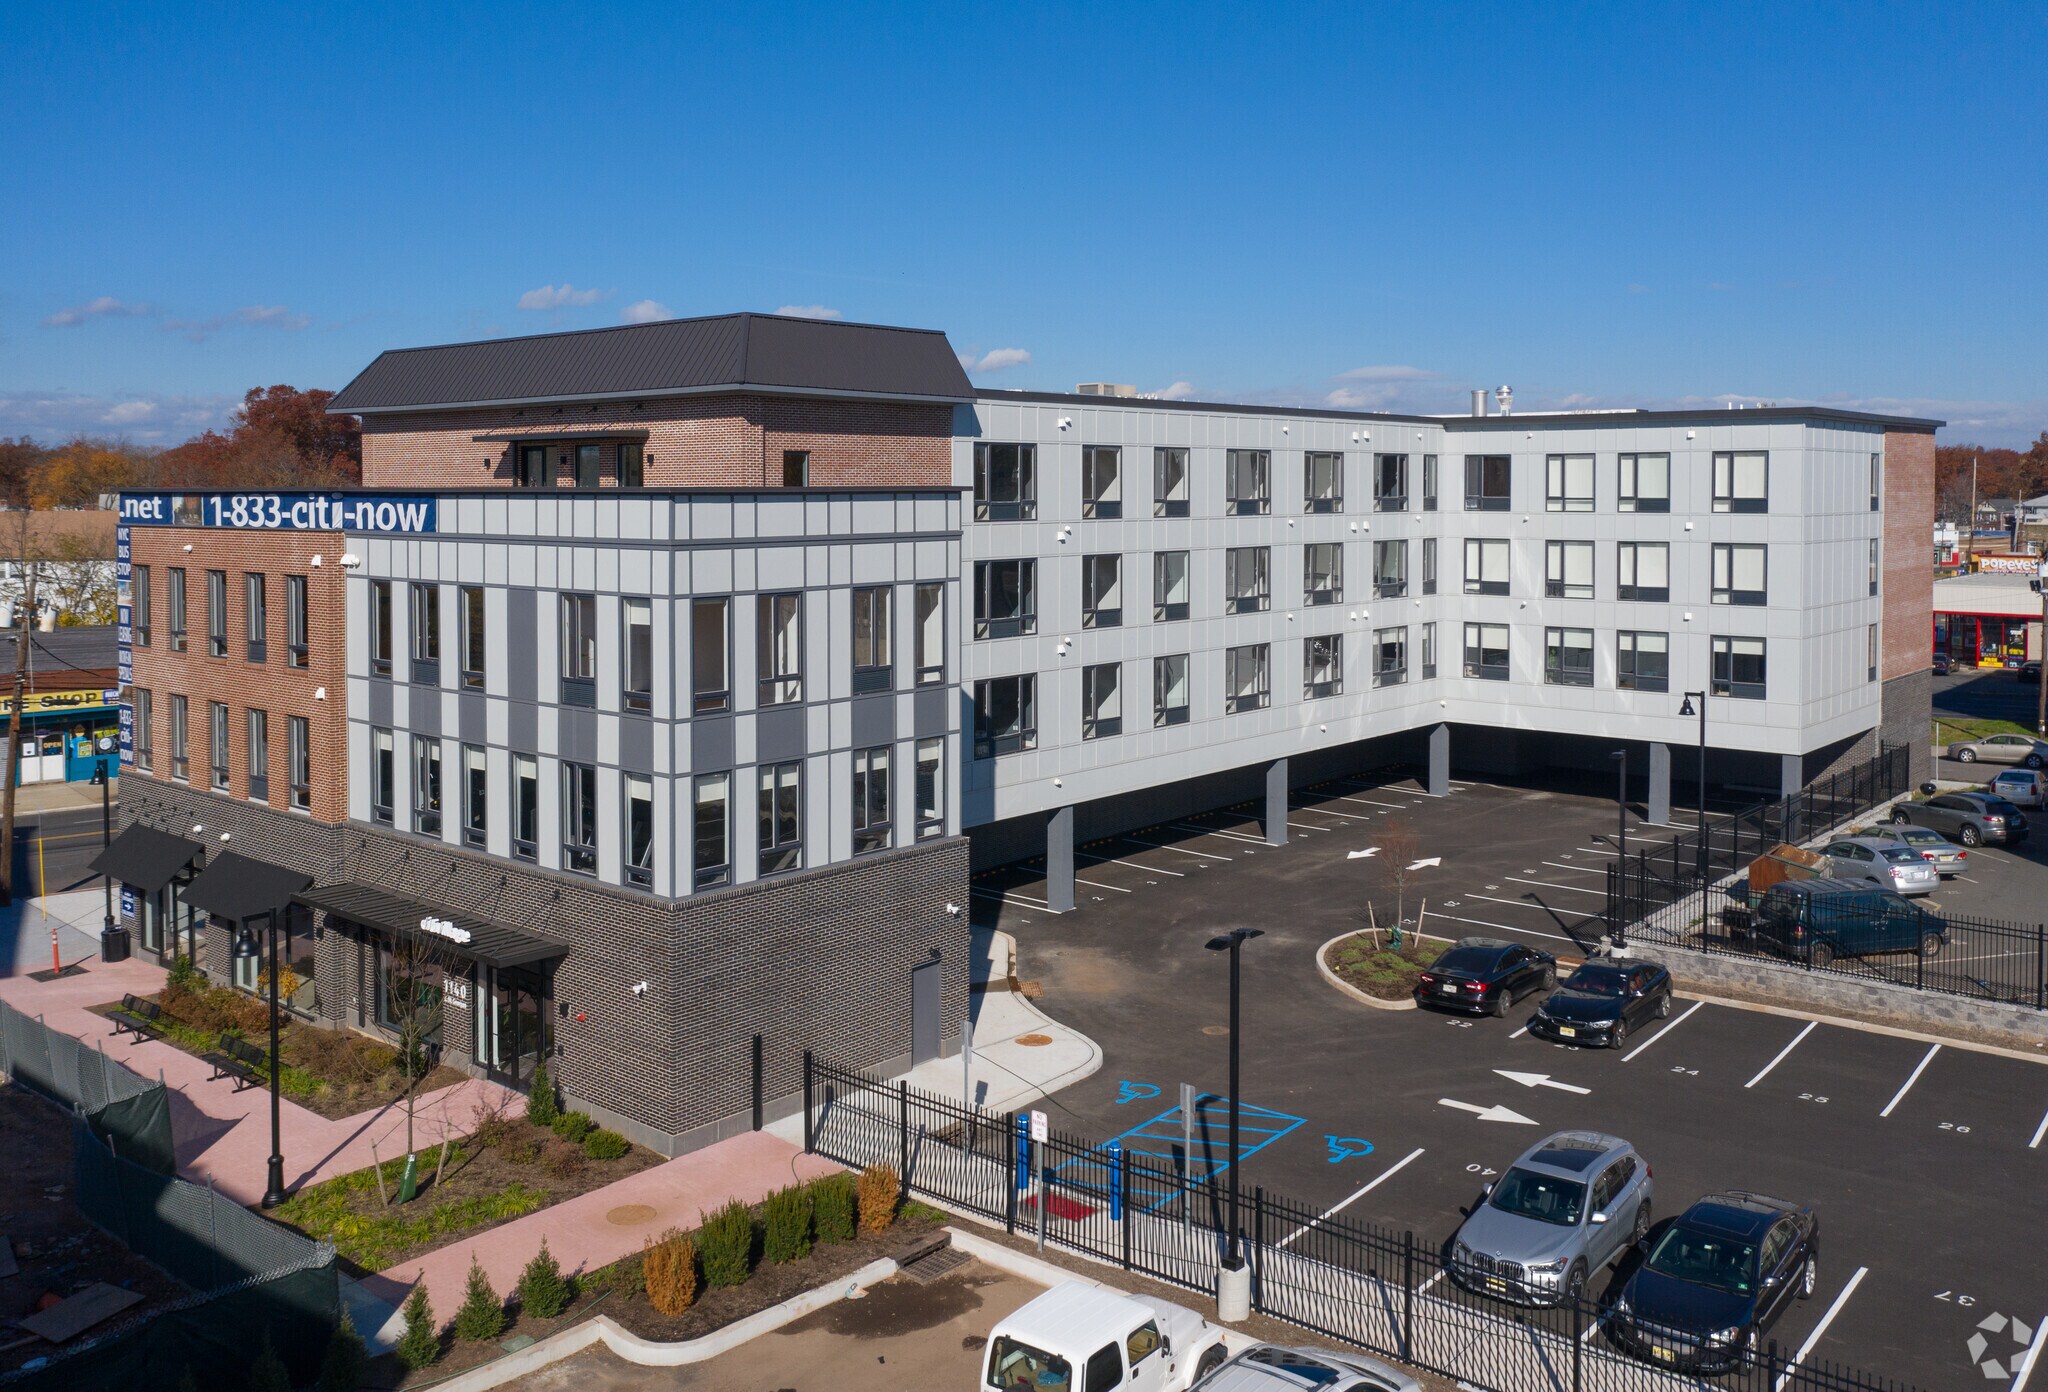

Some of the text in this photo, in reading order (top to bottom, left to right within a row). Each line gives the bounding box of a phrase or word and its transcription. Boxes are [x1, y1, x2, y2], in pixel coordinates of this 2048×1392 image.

[118, 528, 130, 541] NYC
[118, 545, 130, 558] BUS
[117, 563, 132, 576] STOP
[43, 741, 62, 749] OPEN
[1446, 1019, 1473, 1029] 22
[1671, 1065, 1700, 1076] 24
[1798, 1093, 1830, 1104] 25
[1938, 1122, 1971, 1134] 26
[1465, 1163, 1498, 1177] 40
[1933, 1290, 1976, 1307] 37
